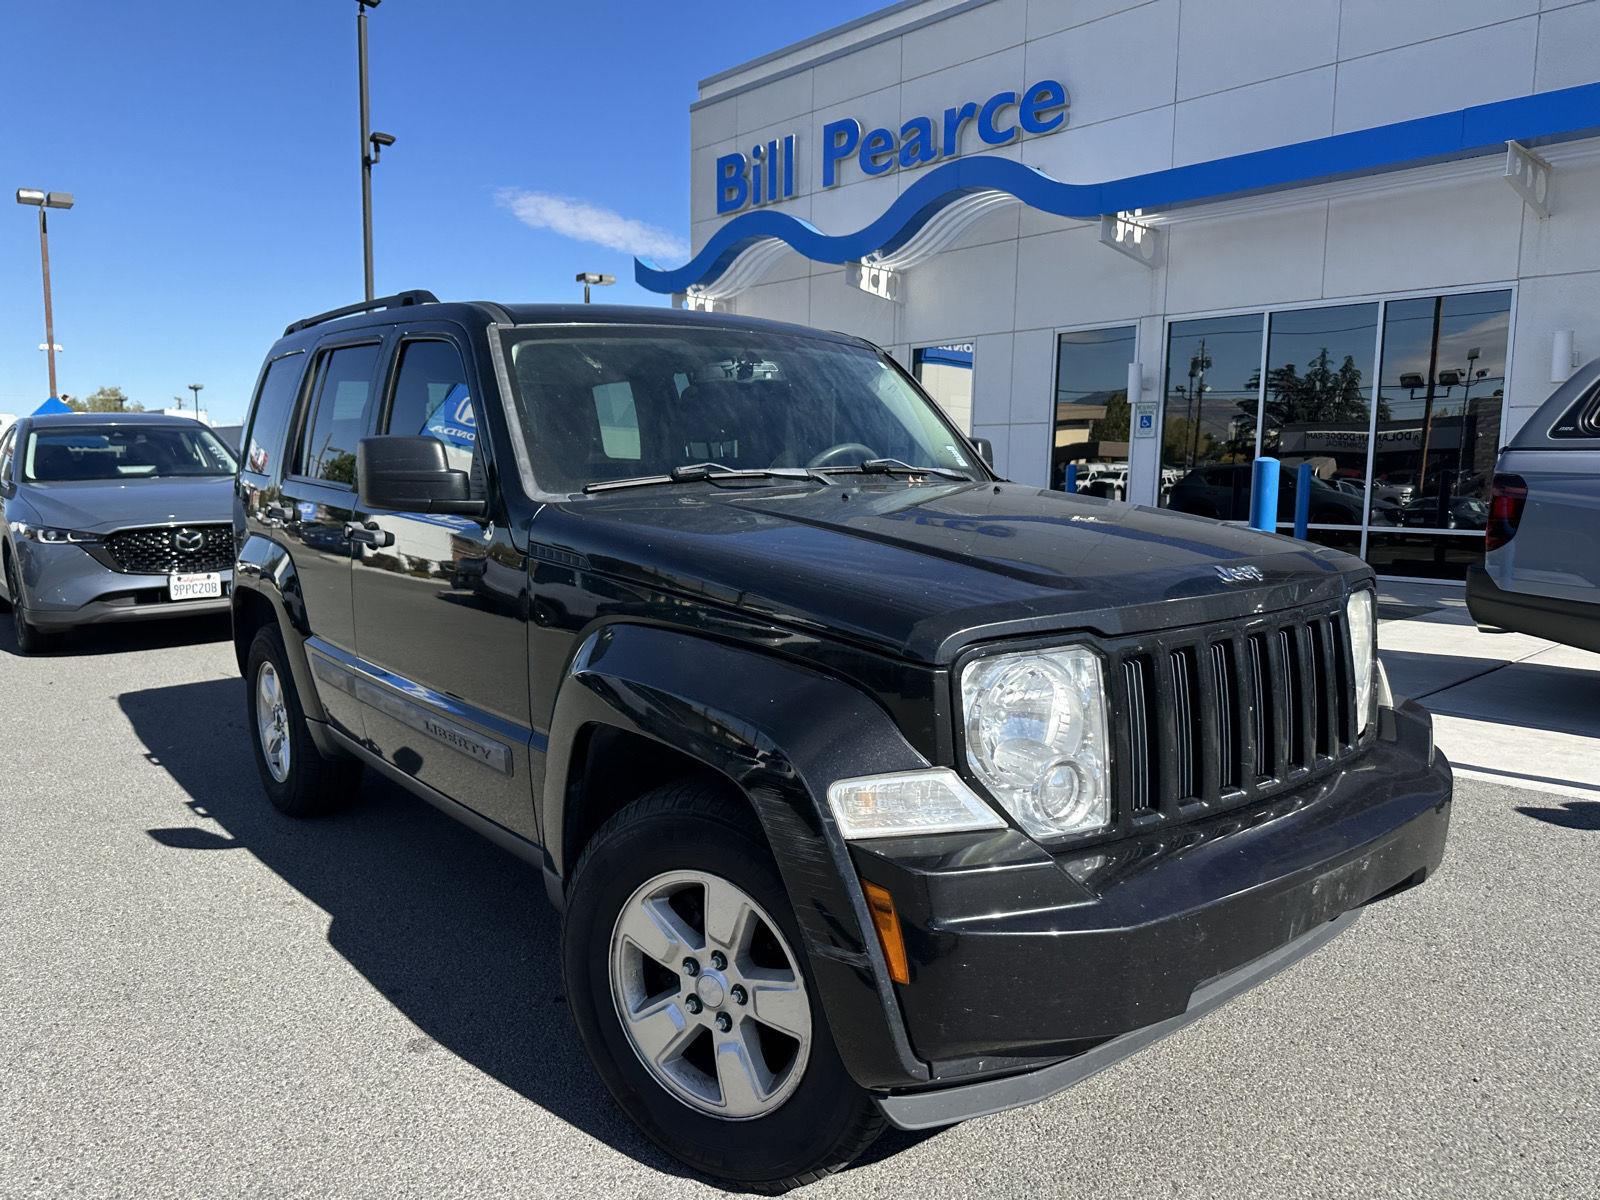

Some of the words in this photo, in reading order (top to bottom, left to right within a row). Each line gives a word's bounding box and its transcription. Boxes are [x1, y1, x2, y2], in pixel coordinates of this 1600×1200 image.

[716, 133, 797, 216] Bill
[822, 79, 1070, 189] Pearce
[1214, 565, 1263, 583] Jeep
[425, 721, 491, 759] LIBERTY
